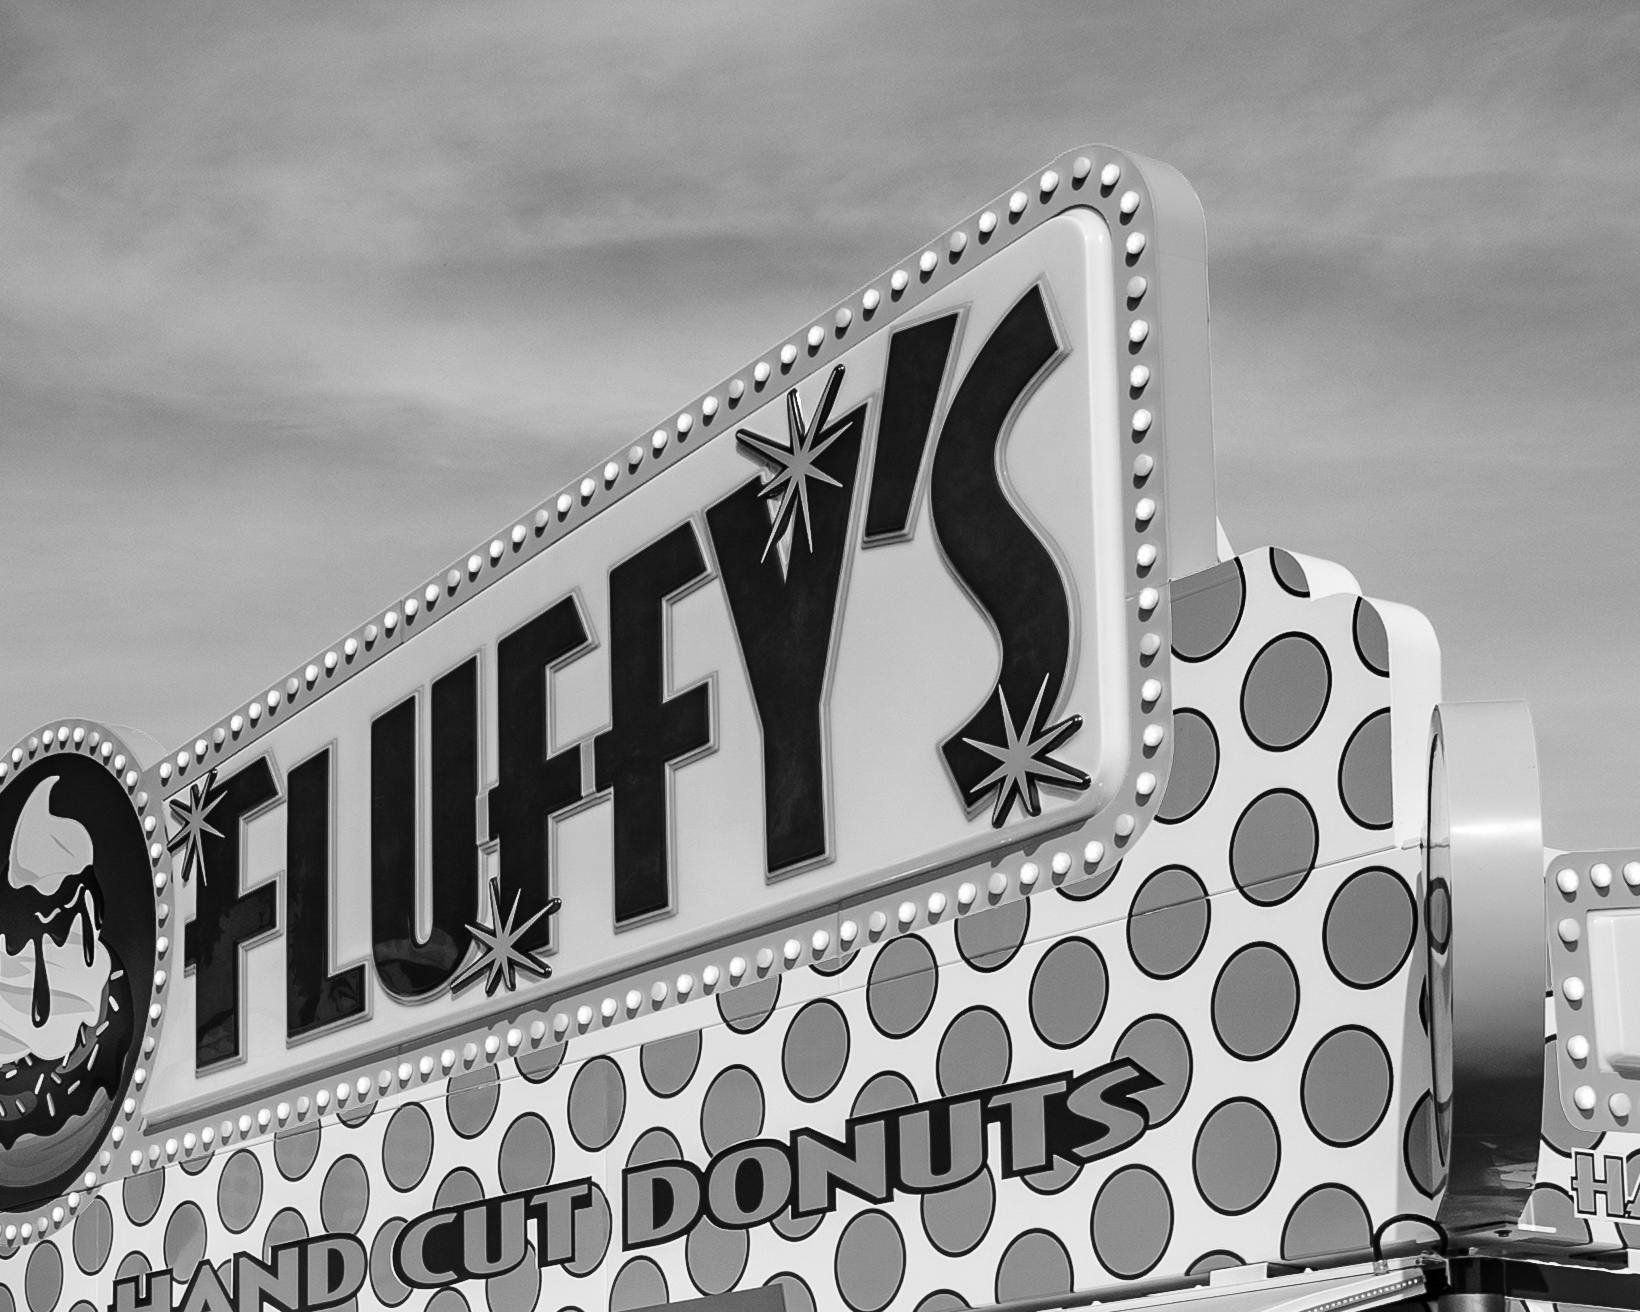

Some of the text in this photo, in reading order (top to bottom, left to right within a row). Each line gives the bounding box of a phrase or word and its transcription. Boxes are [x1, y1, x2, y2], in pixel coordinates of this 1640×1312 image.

[182, 272, 1074, 1078] FLUFFY'S
[393, 1177, 592, 1289] CUT
[622, 1057, 1164, 1251] DONUTS
